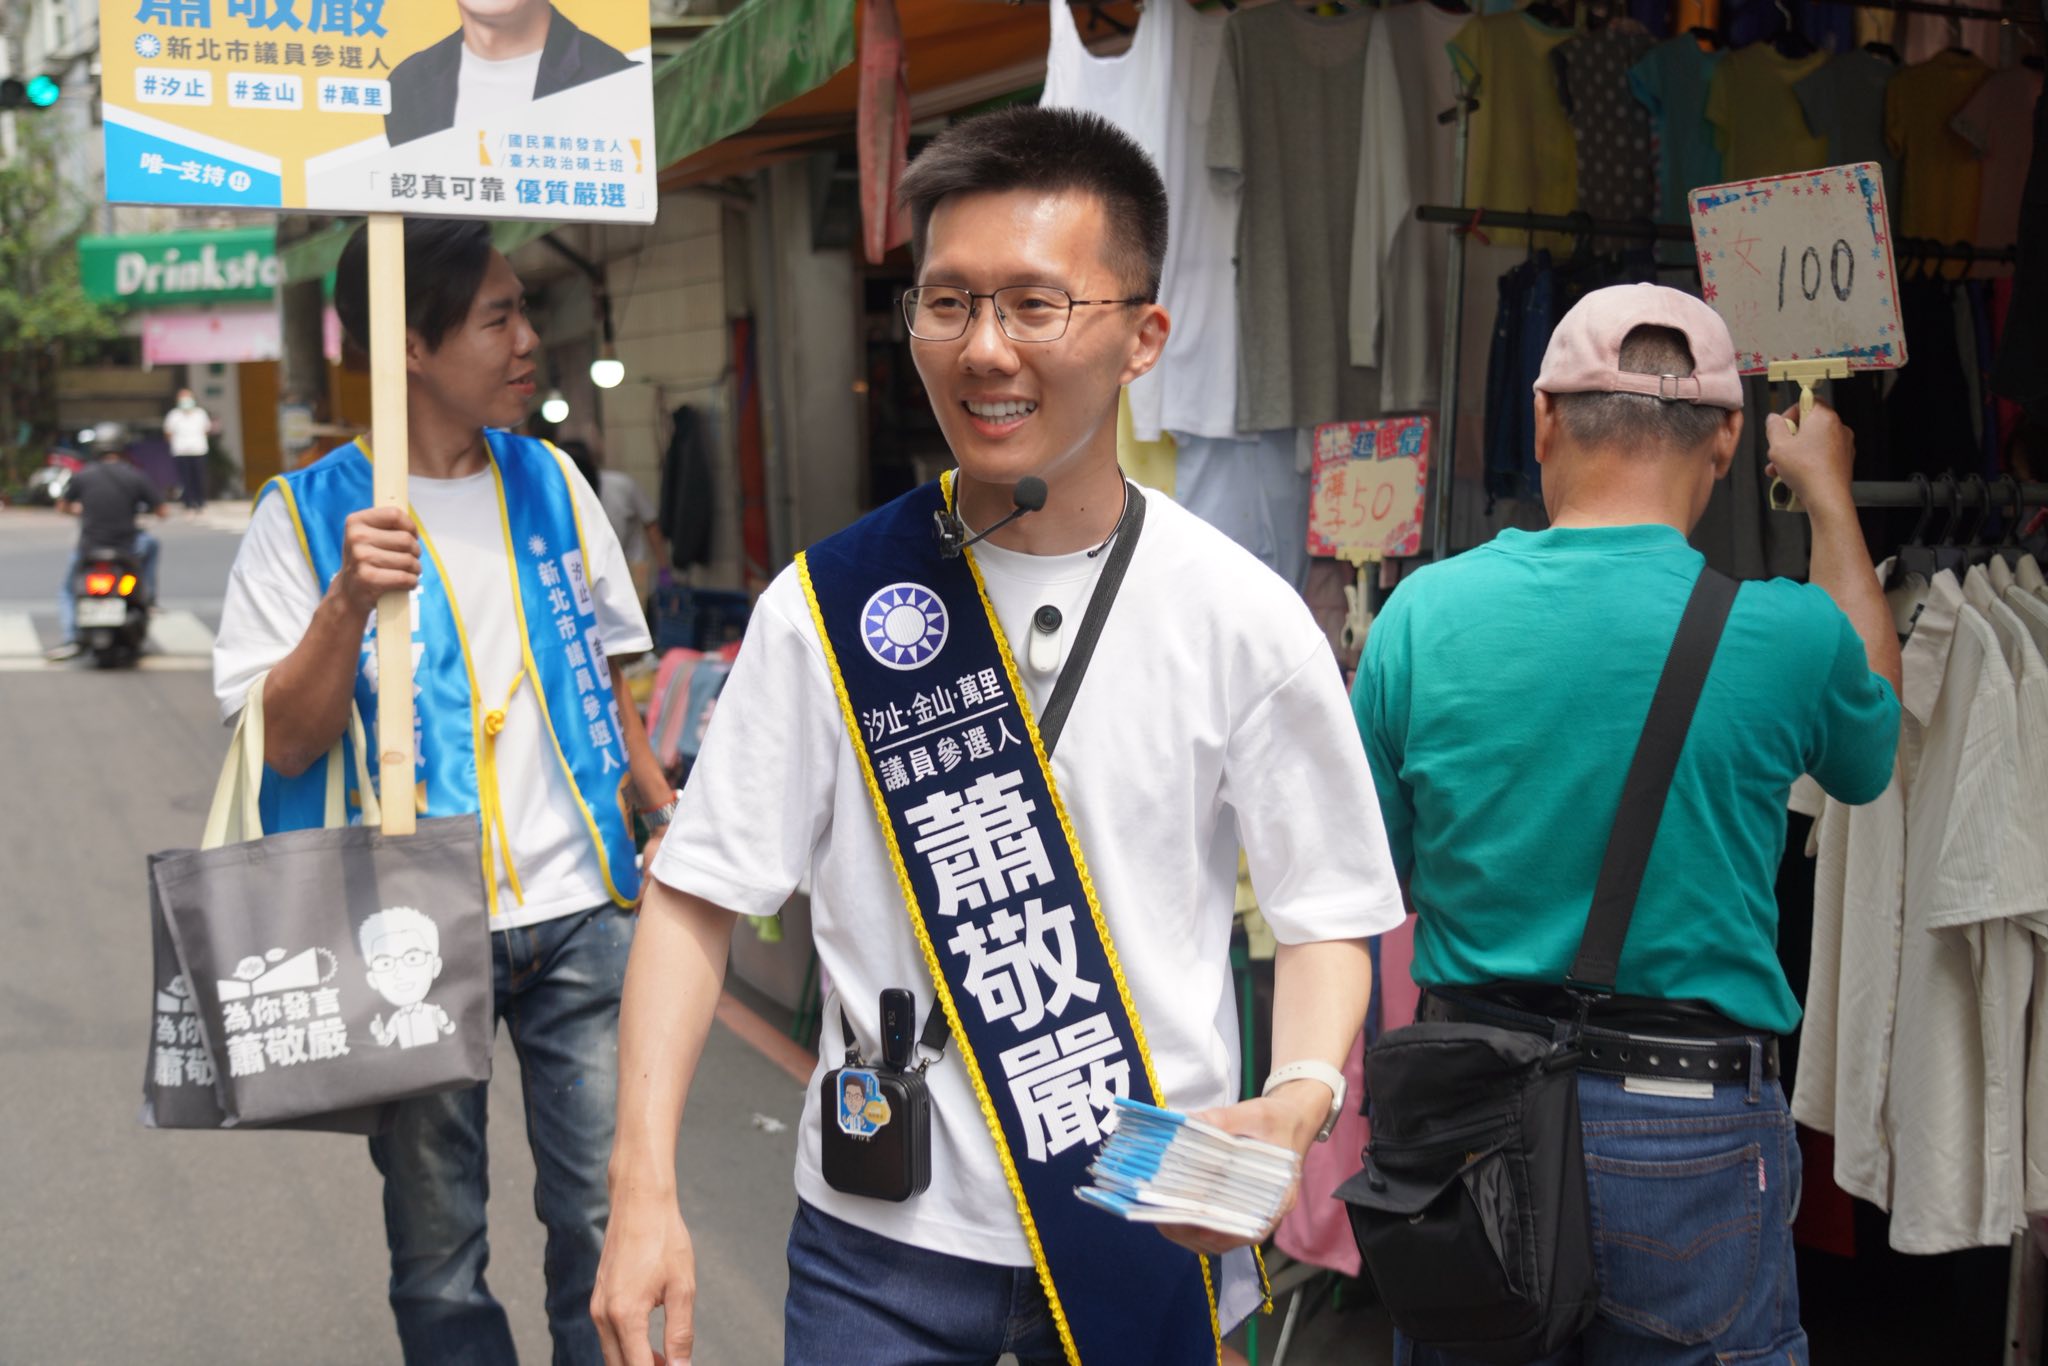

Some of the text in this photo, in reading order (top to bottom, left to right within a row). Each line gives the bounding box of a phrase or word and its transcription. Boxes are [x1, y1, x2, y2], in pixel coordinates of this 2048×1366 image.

[167, 35, 390, 70] 新北市議員參選人
[143, 75, 206, 98] #汐止
[234, 79, 296, 103] #金山
[324, 84, 383, 107] #萬里
[1776, 238, 1855, 312] 100
[1351, 476, 1396, 528] 50
[538, 559, 621, 774] 新北市議員參選人
[879, 717, 1022, 792] 議員參選人
[904, 769, 1131, 1163] 蕭敬嚴
[222, 986, 340, 1034] 為你發言
[225, 1016, 351, 1079] 蕭敬嚴
